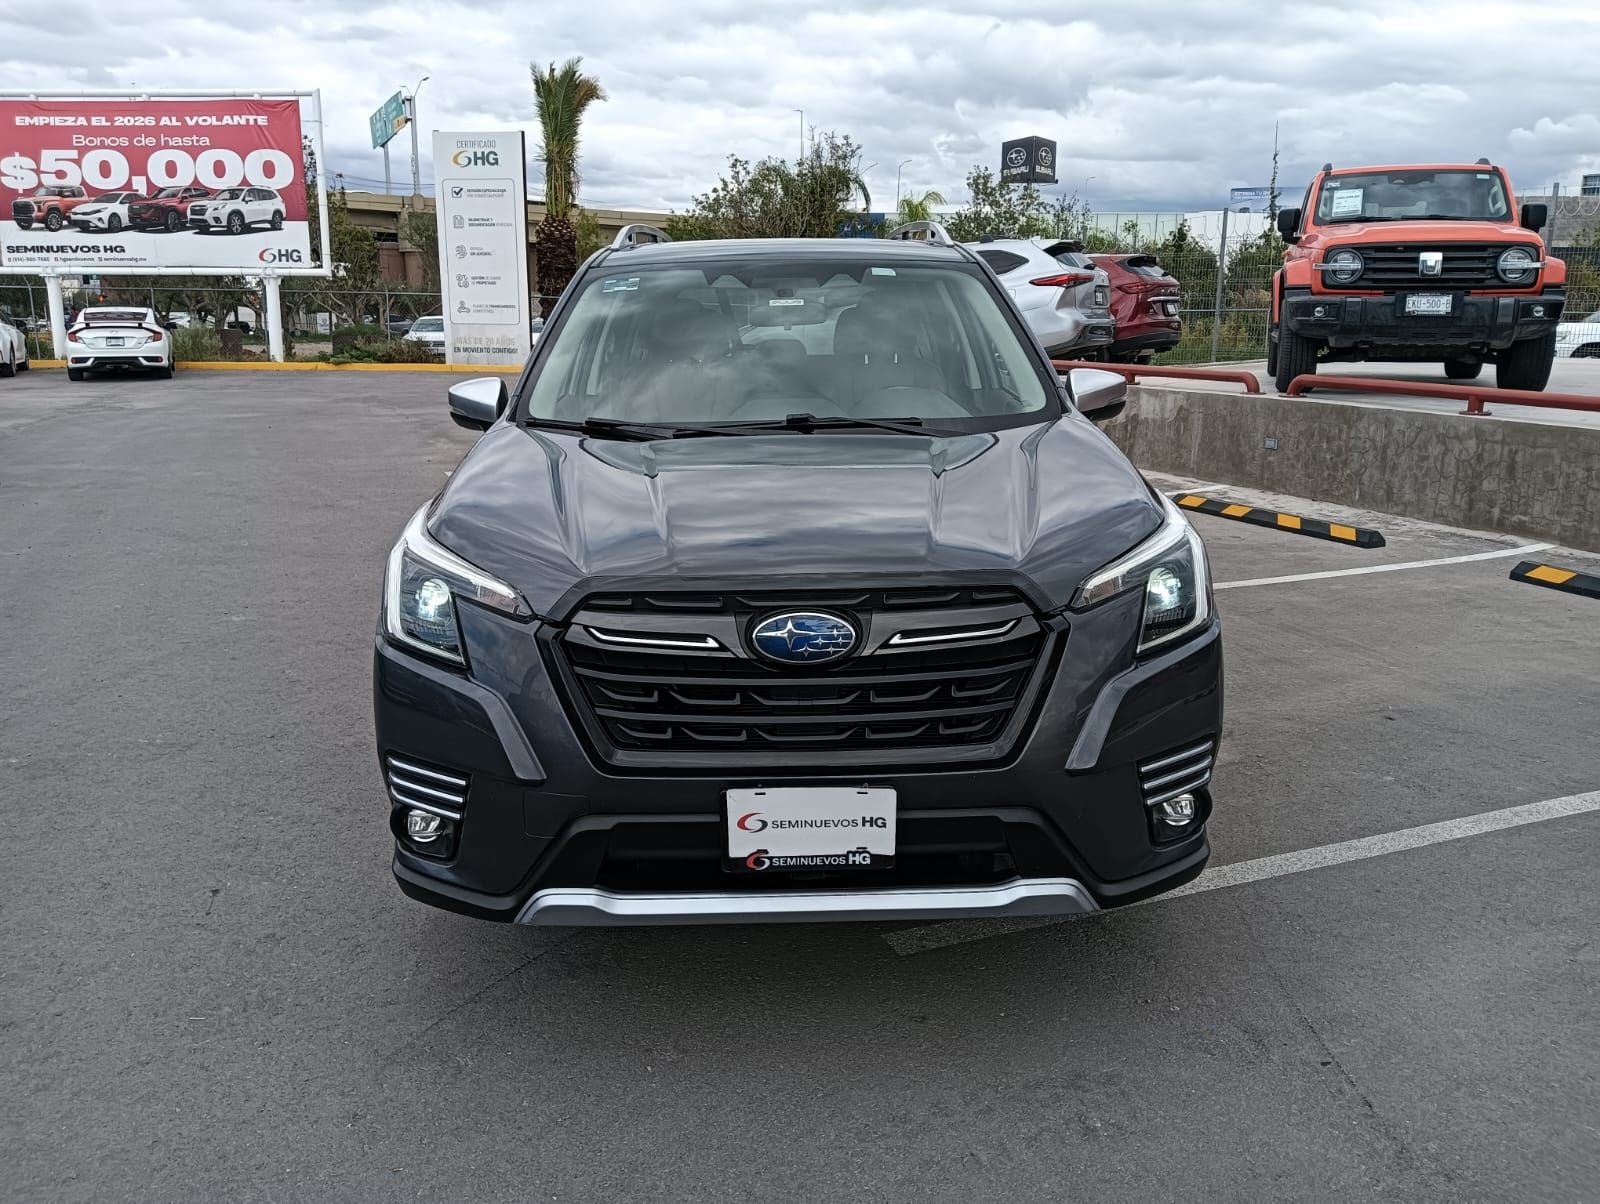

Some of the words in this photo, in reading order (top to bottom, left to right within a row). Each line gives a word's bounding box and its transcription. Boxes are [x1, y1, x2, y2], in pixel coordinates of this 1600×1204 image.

[15, 115, 88, 127] EMPIEZA
[91, 116, 111, 126] EL
[114, 116, 156, 126] 2026
[159, 116, 181, 126] AL
[184, 114, 268, 126] VOLANTE
[72, 134, 129, 147] Bonos
[133, 133, 156, 147] de
[160, 133, 211, 147] hasta
[456, 140, 496, 149] CERTIFICADO
[473, 150, 499, 167] HG
[0, 148, 295, 194] $50,000
[6, 245, 101, 254] SEMINUEVOS
[103, 245, 126, 254] HG
[277, 248, 302, 262] HG
[771, 818, 859, 829] SEMINUEVOS
[861, 816, 887, 828] HG
[771, 856, 846, 866] SEMINUEVOS
[848, 852, 871, 864] HG
